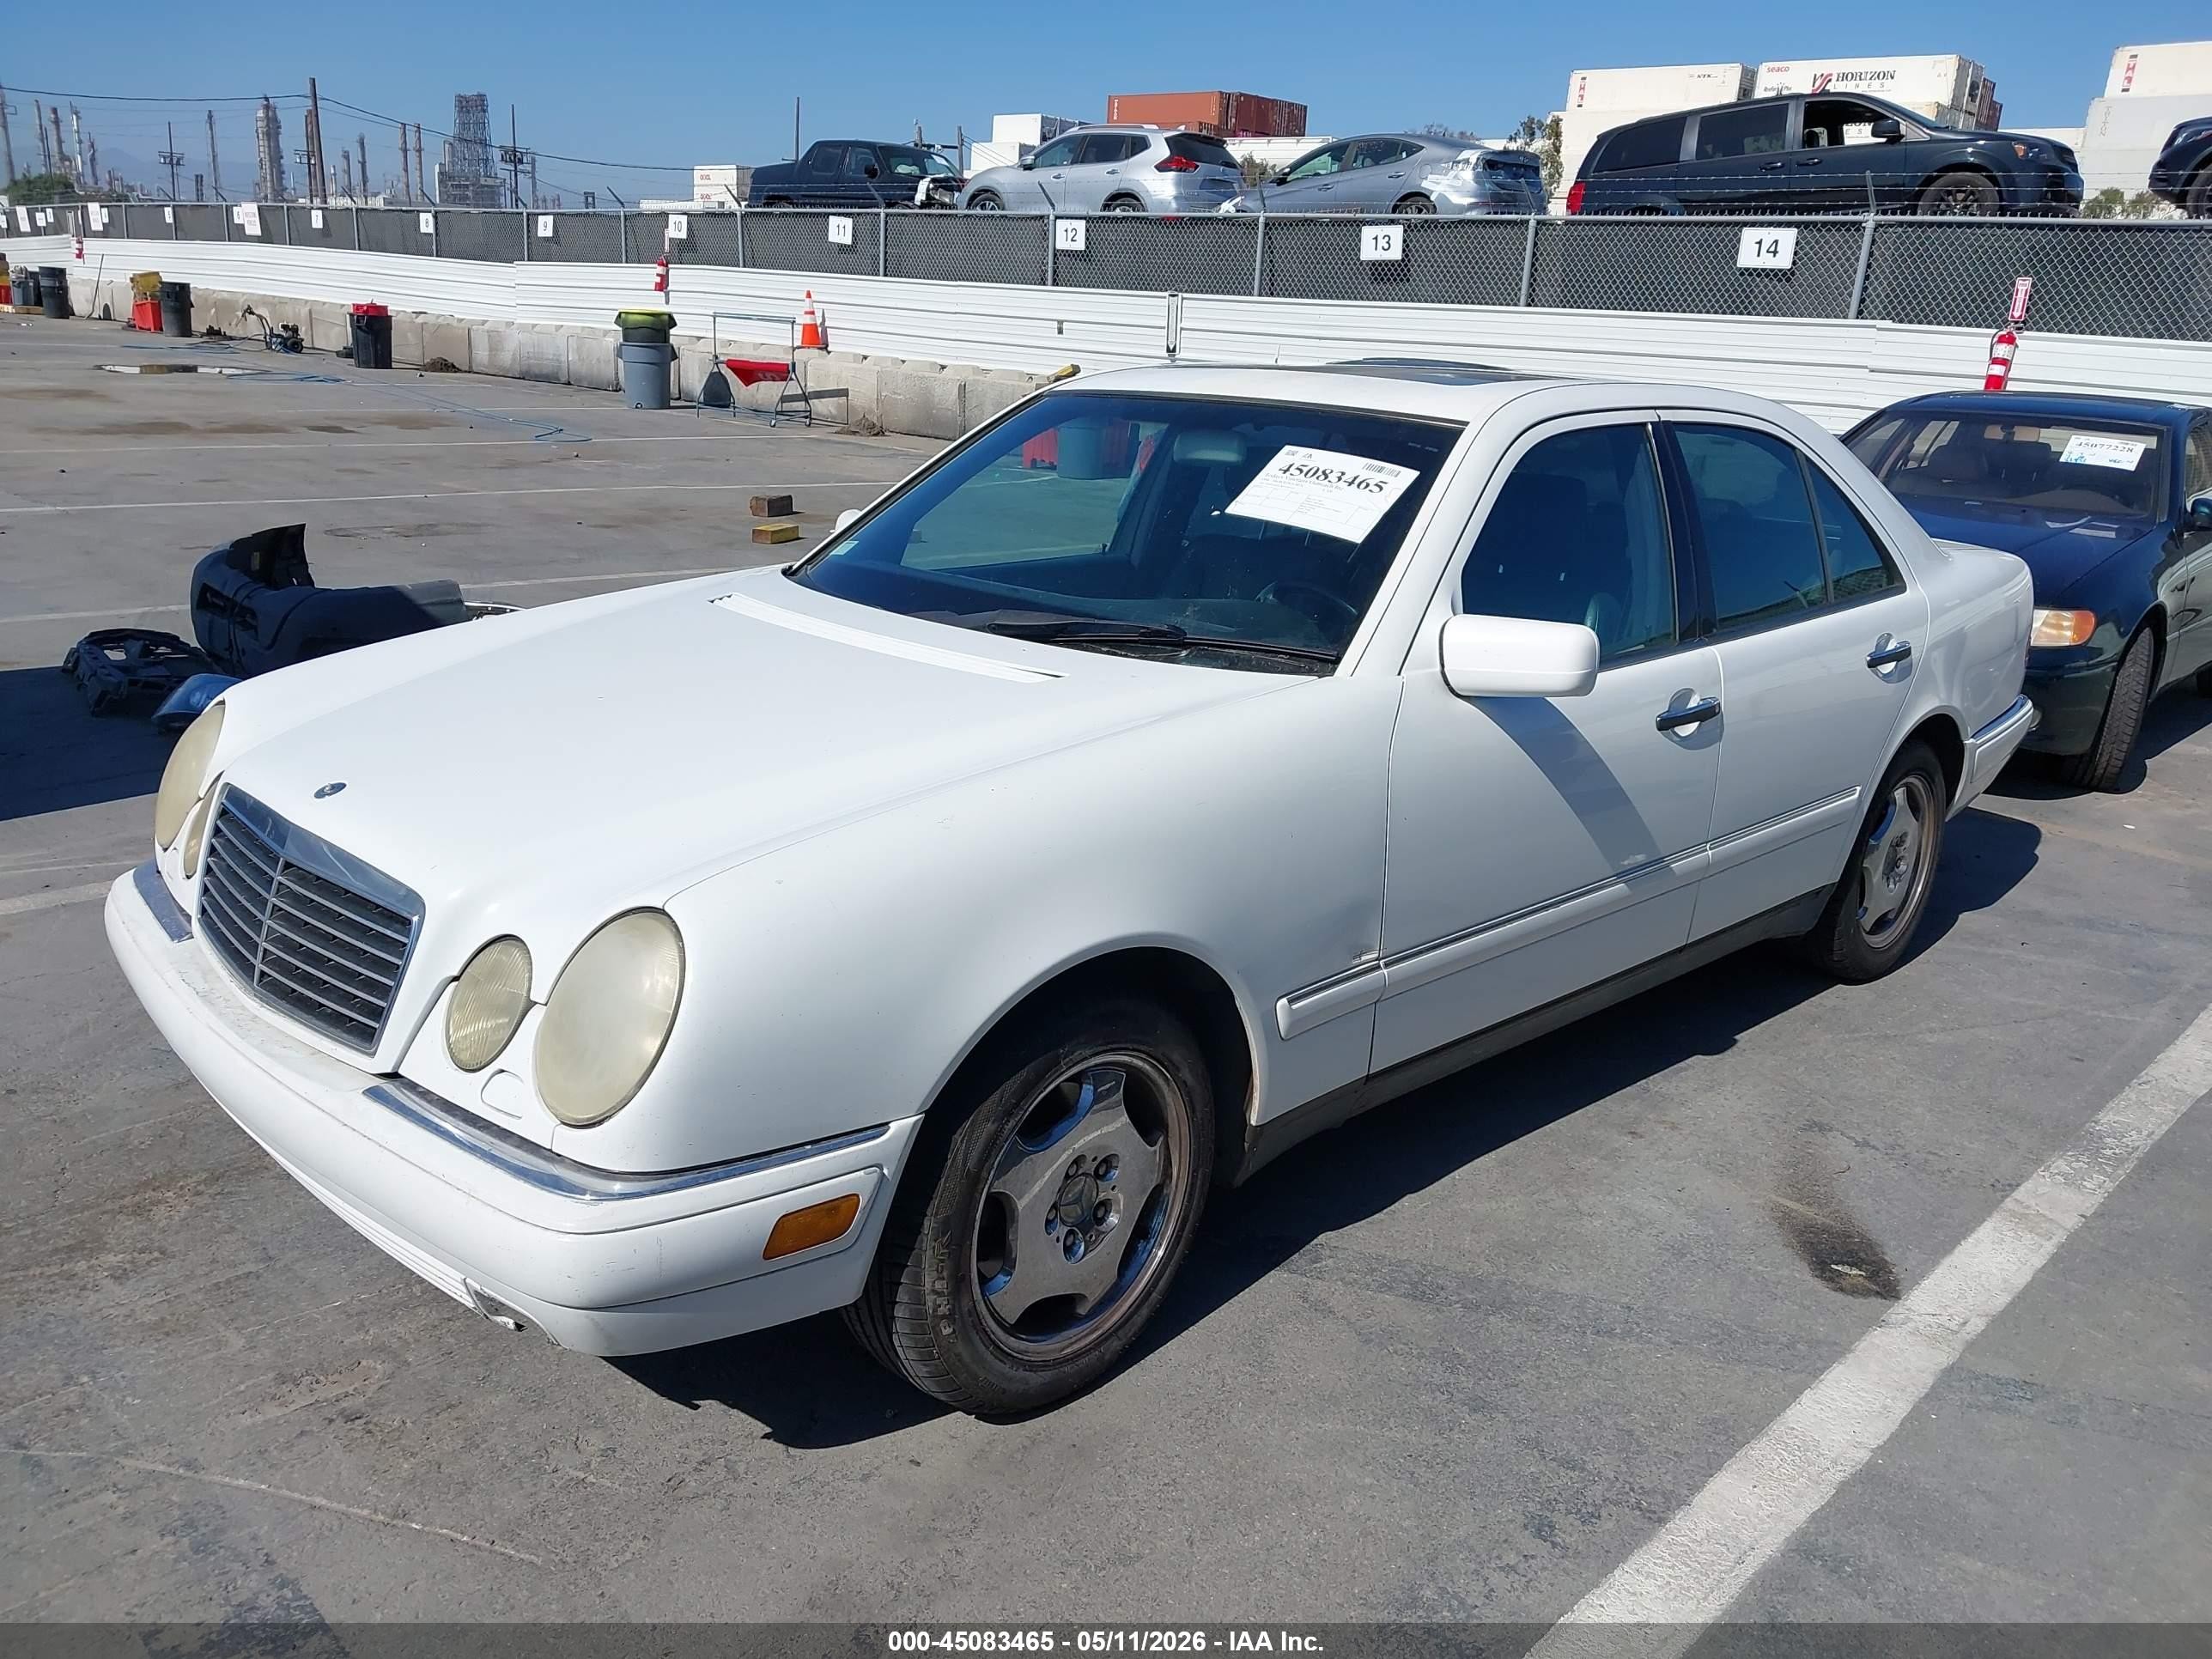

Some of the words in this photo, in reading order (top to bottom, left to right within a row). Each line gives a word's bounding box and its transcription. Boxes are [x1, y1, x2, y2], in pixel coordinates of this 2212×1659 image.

[1835, 70, 1897, 82] HORIZON
[1833, 82, 1886, 90] LINES
[425, 217, 429, 228] 8
[543, 220, 548, 232] 9
[672, 220, 683, 234] 10
[836, 222, 847, 238] 11
[1064, 227, 1078, 242] 12
[1371, 234, 1392, 252] 13
[1753, 238, 1780, 258] 14
[1278, 461, 1389, 494] 45083465
